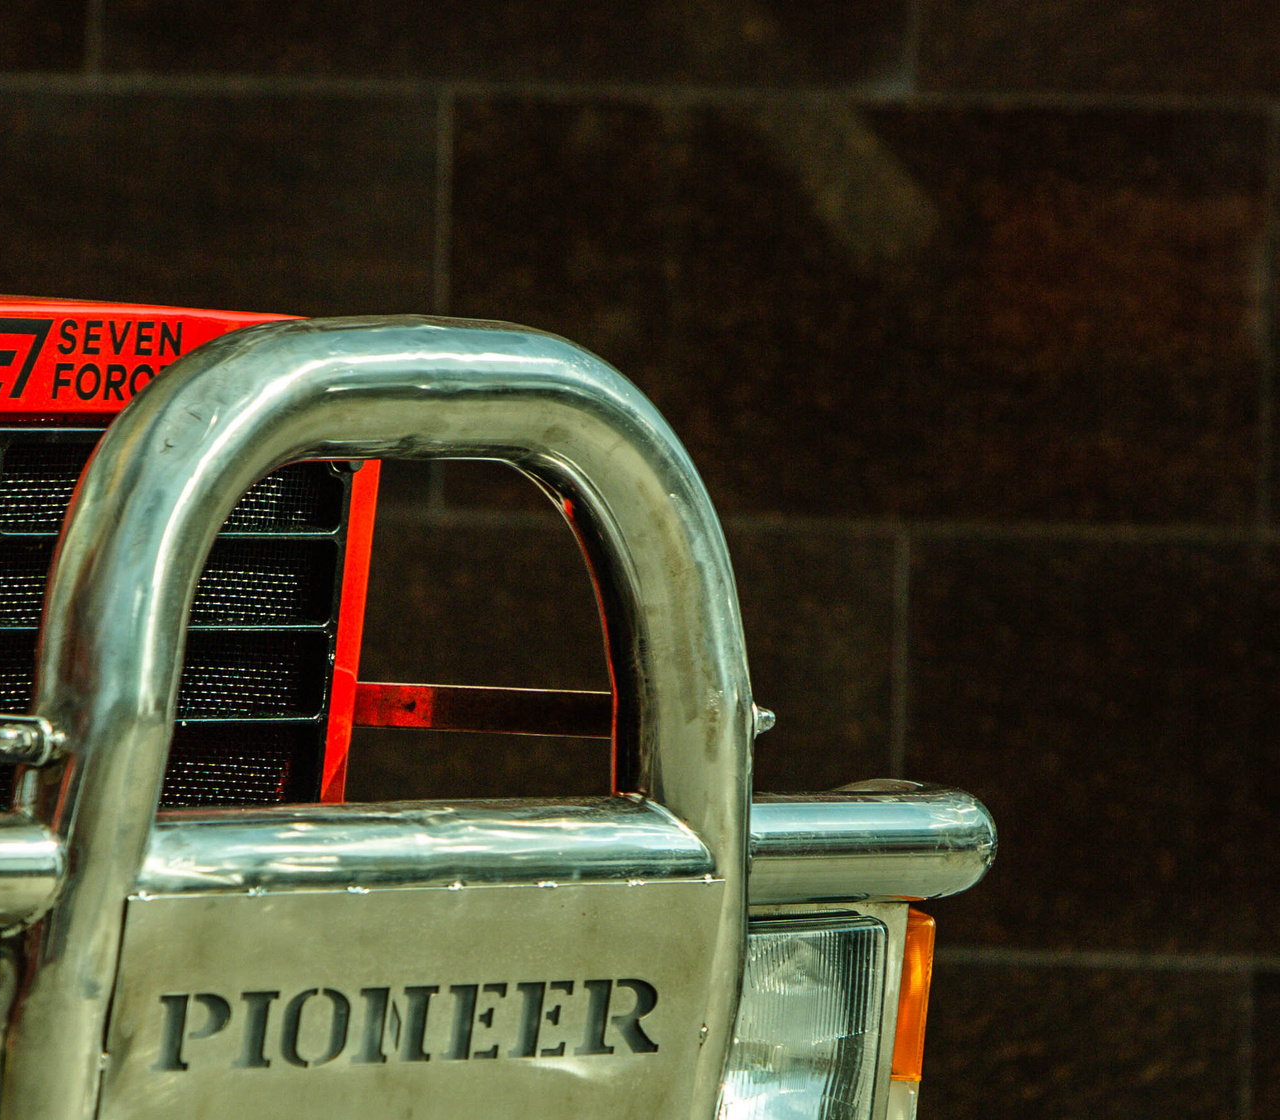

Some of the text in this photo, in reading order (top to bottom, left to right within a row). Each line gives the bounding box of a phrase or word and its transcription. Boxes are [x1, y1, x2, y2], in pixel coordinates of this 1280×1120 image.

[56, 319, 183, 357] SEVEN
[51, 362, 174, 401] FORC
[150, 978, 660, 1072] PIONEER
